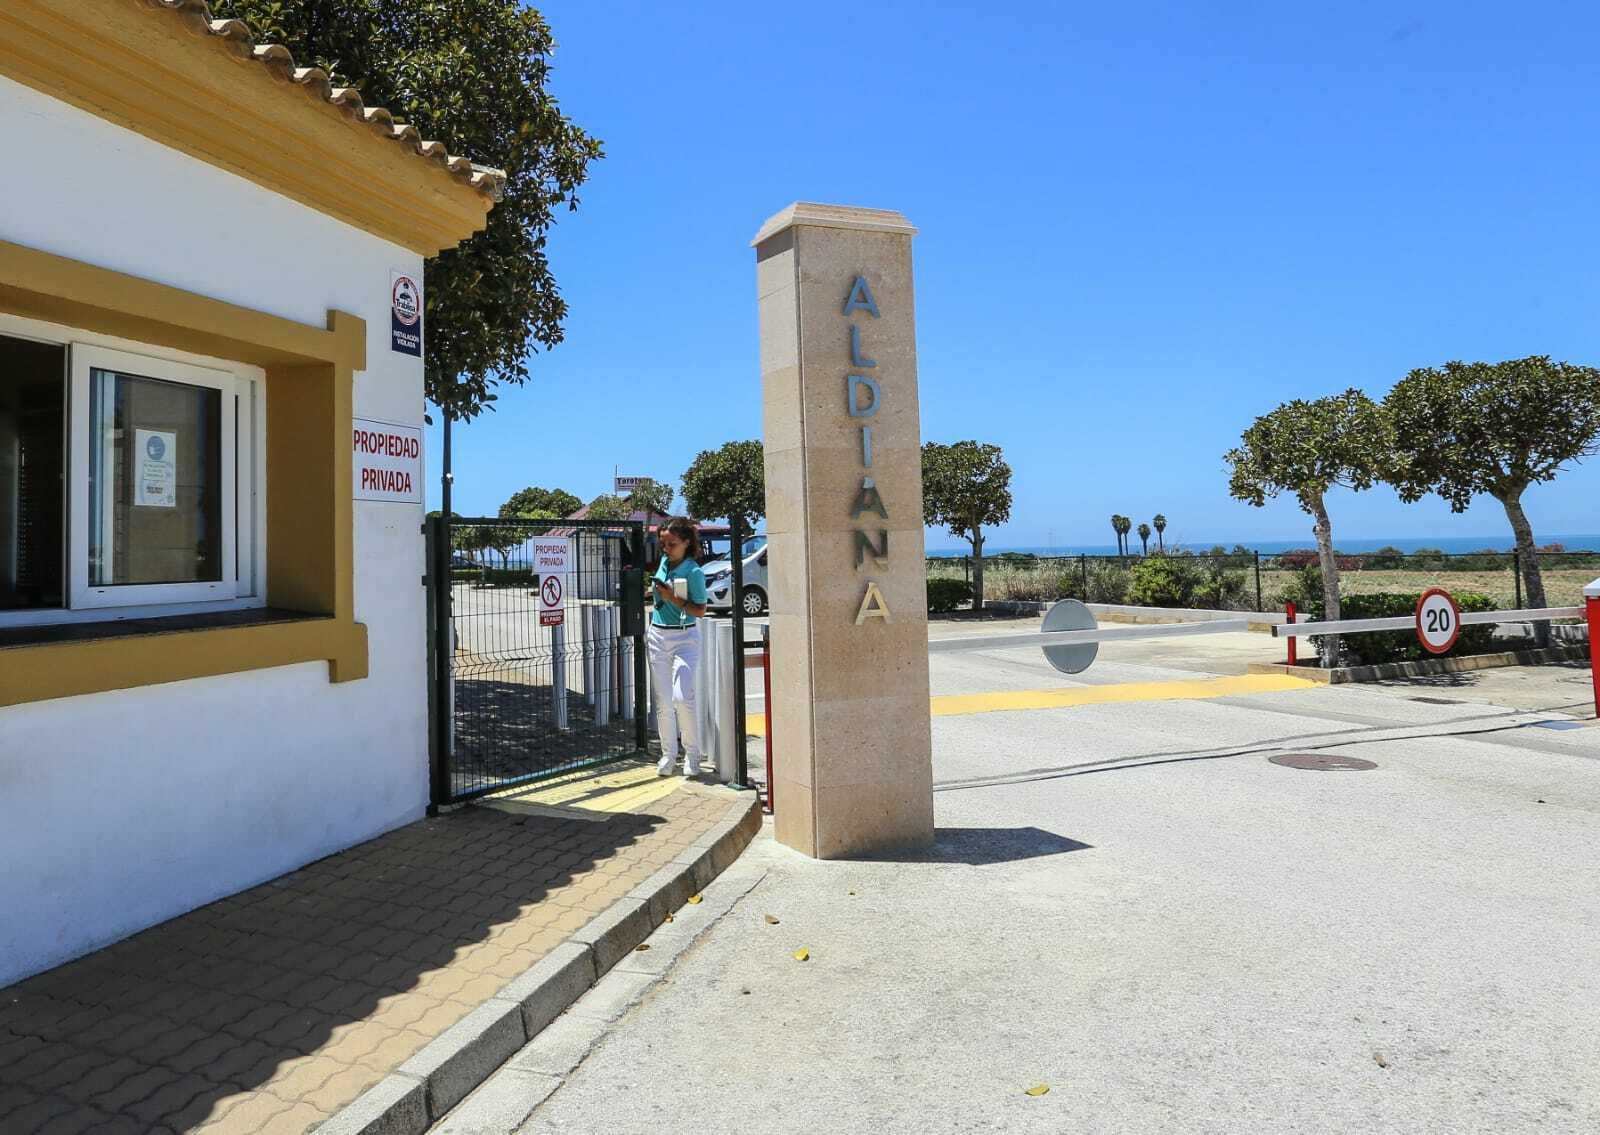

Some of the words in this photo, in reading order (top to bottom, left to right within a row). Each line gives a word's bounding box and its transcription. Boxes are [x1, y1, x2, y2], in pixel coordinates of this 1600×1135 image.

[353, 429, 419, 459] PROPIEDAD
[842, 275, 891, 626] ALDIANA
[362, 468, 412, 493] PRIVADA
[535, 544, 567, 555] PROPIEDAD
[540, 557, 564, 567] PRIVADA
[1427, 608, 1450, 632] 20
